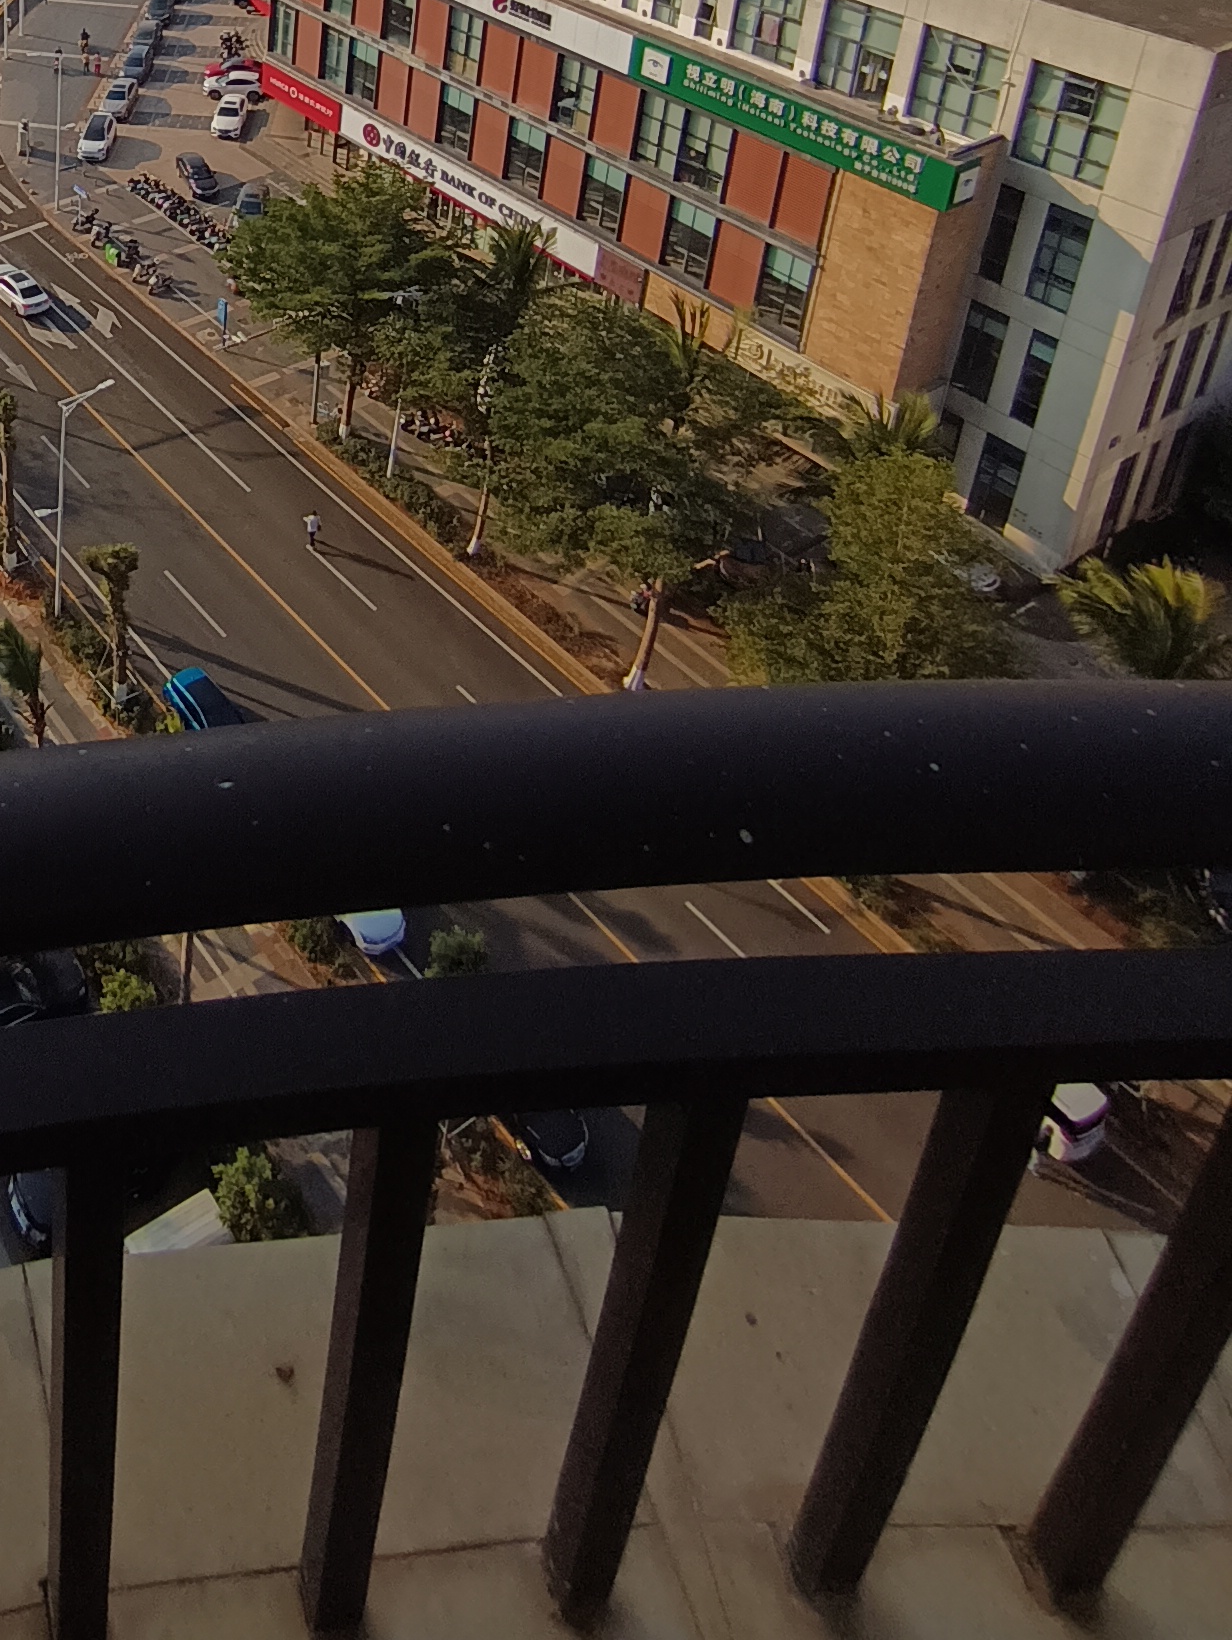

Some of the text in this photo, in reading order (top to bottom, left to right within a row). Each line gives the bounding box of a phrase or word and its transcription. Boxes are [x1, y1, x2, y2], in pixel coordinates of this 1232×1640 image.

[382, 134, 438, 180] 中国银行
[789, 121, 858, 159] Technology
[439, 168, 541, 236] BANK OF CHIN
